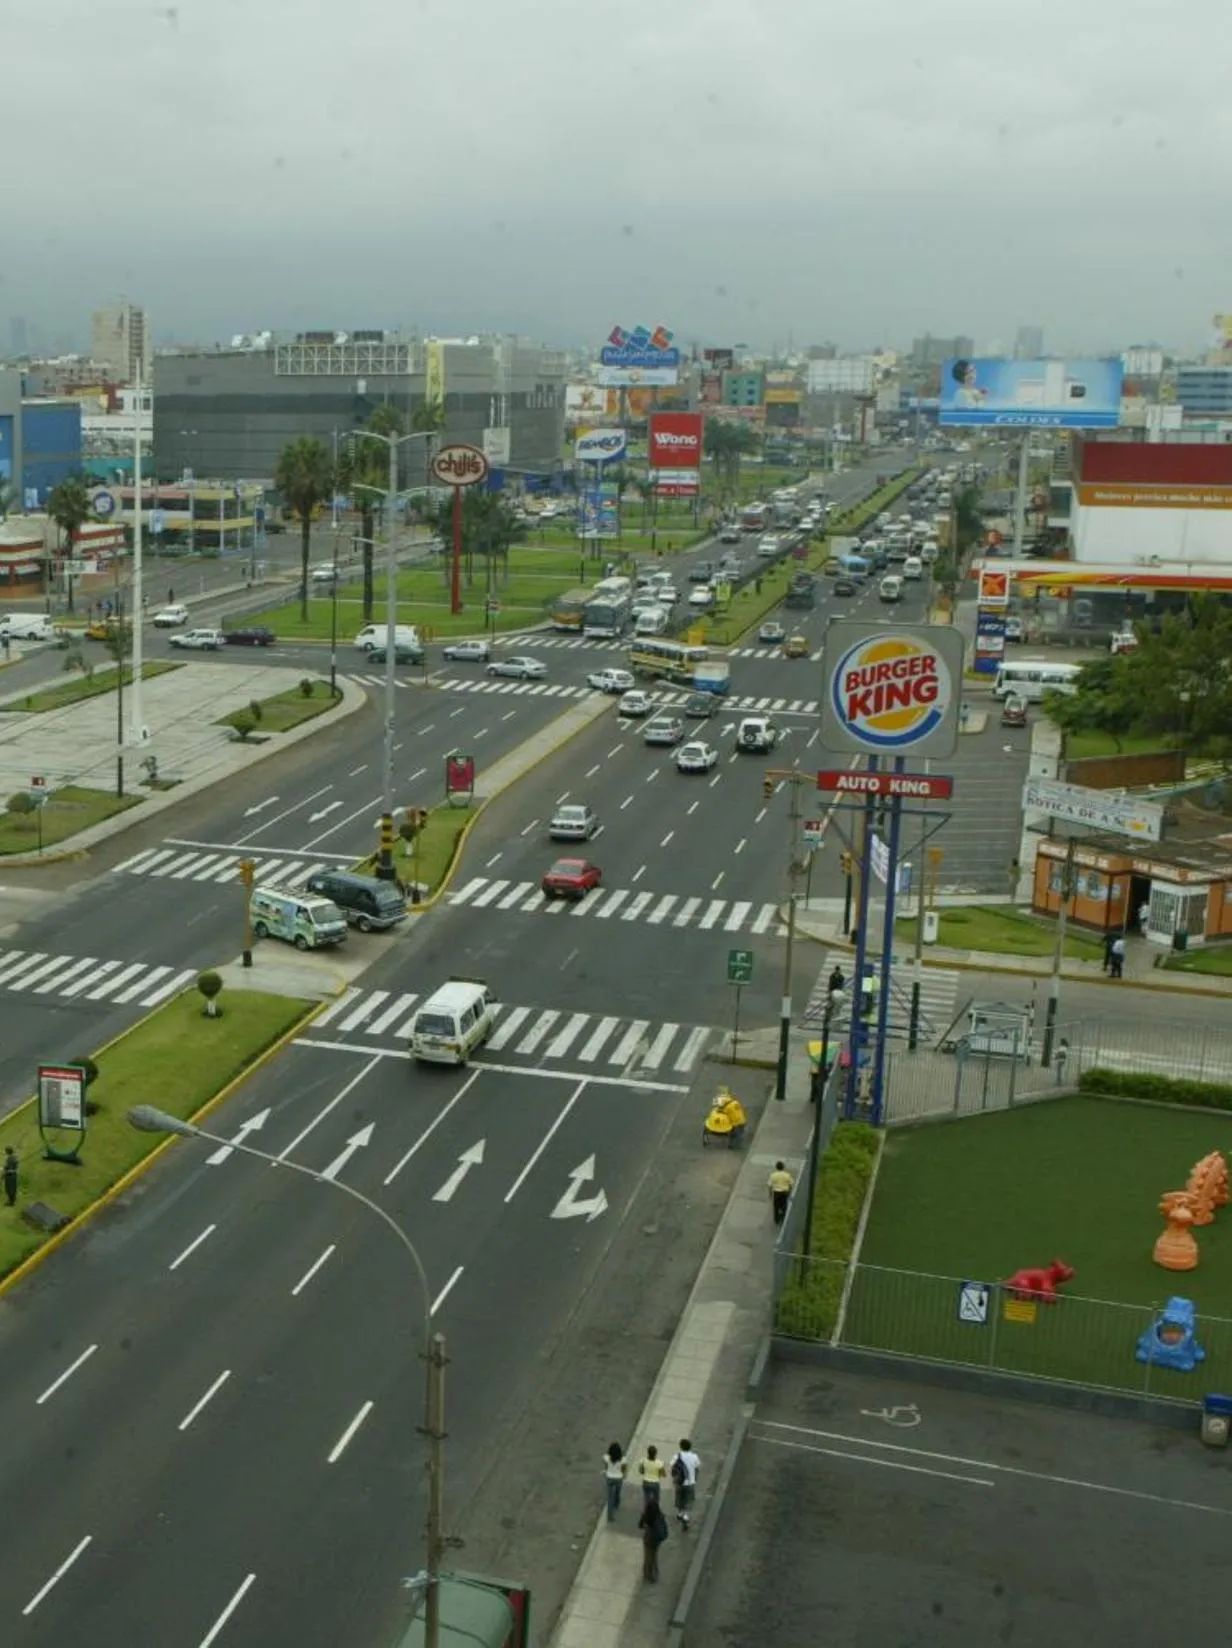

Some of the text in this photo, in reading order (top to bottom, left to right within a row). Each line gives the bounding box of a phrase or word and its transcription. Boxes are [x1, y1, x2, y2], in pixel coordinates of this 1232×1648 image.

[845, 655, 936, 693] BURGER
[848, 675, 939, 721] KING
[836, 775, 931, 794] AUTO KING
